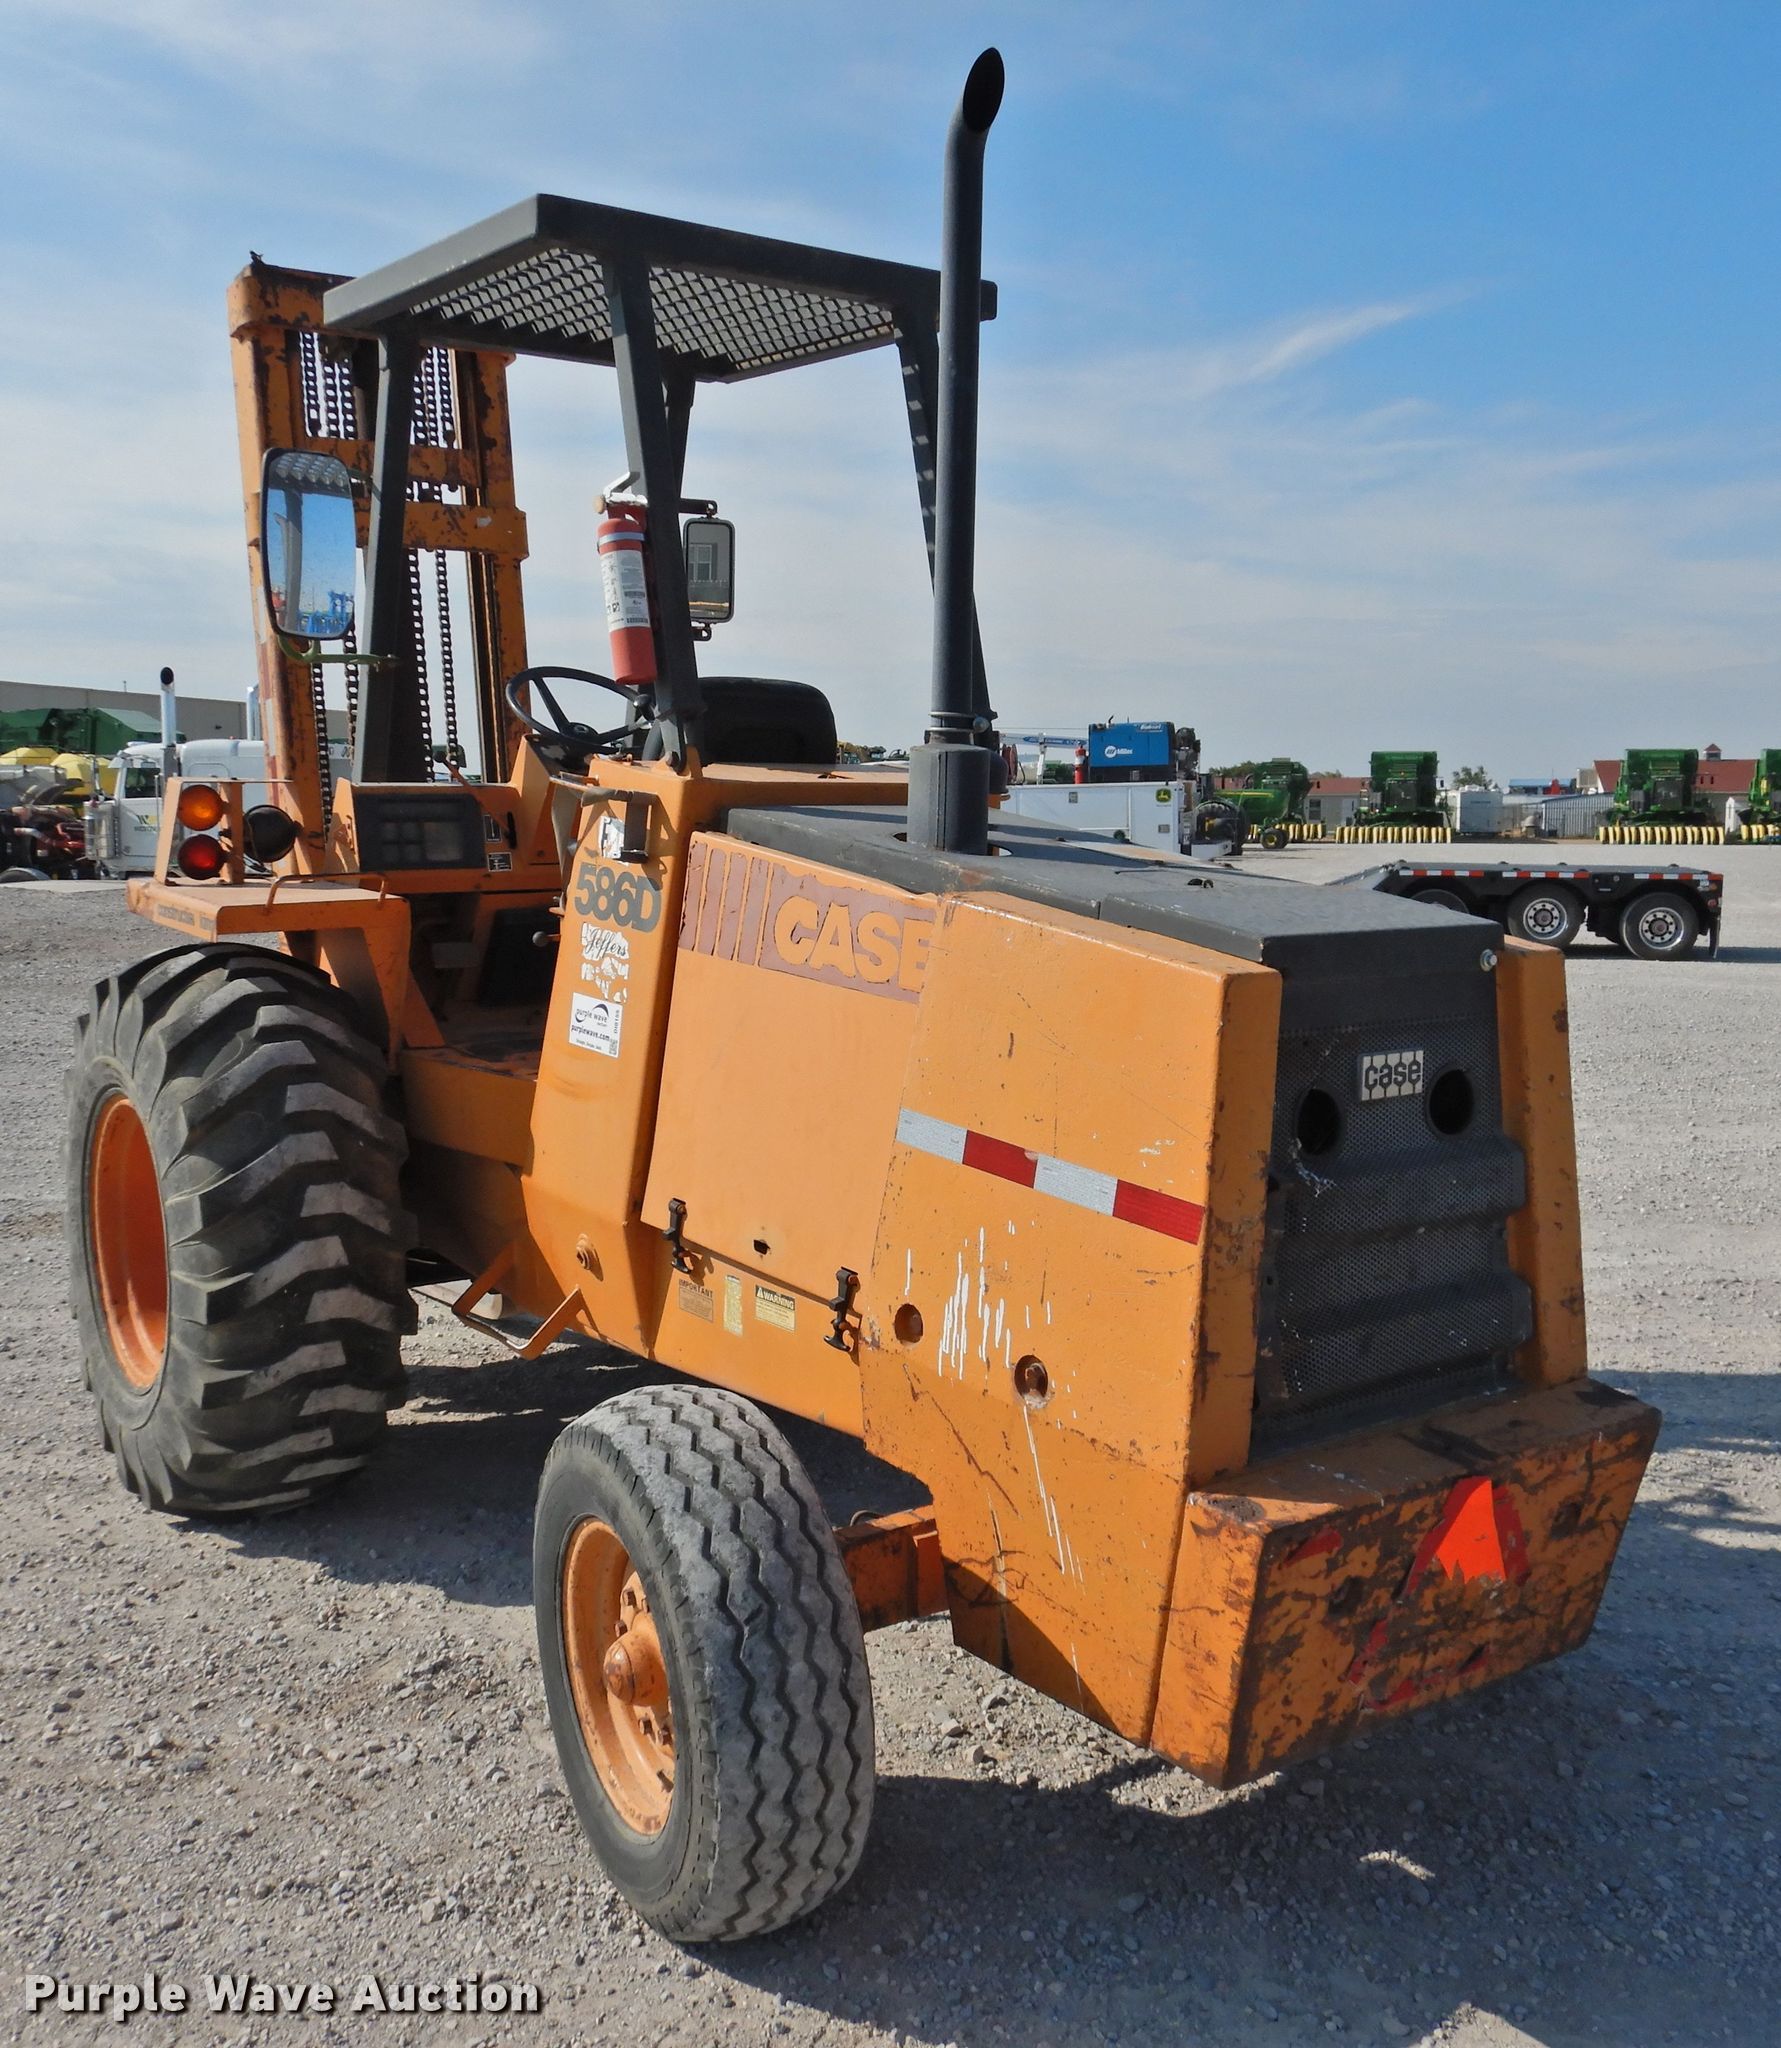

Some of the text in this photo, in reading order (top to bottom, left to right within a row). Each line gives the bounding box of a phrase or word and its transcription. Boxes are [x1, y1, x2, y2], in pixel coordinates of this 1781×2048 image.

[575, 862, 662, 933] 586D
[774, 895, 935, 993] CASE
[680, 1279, 713, 1299] IMPORTANT
[763, 1290, 794, 1310] WARNING
